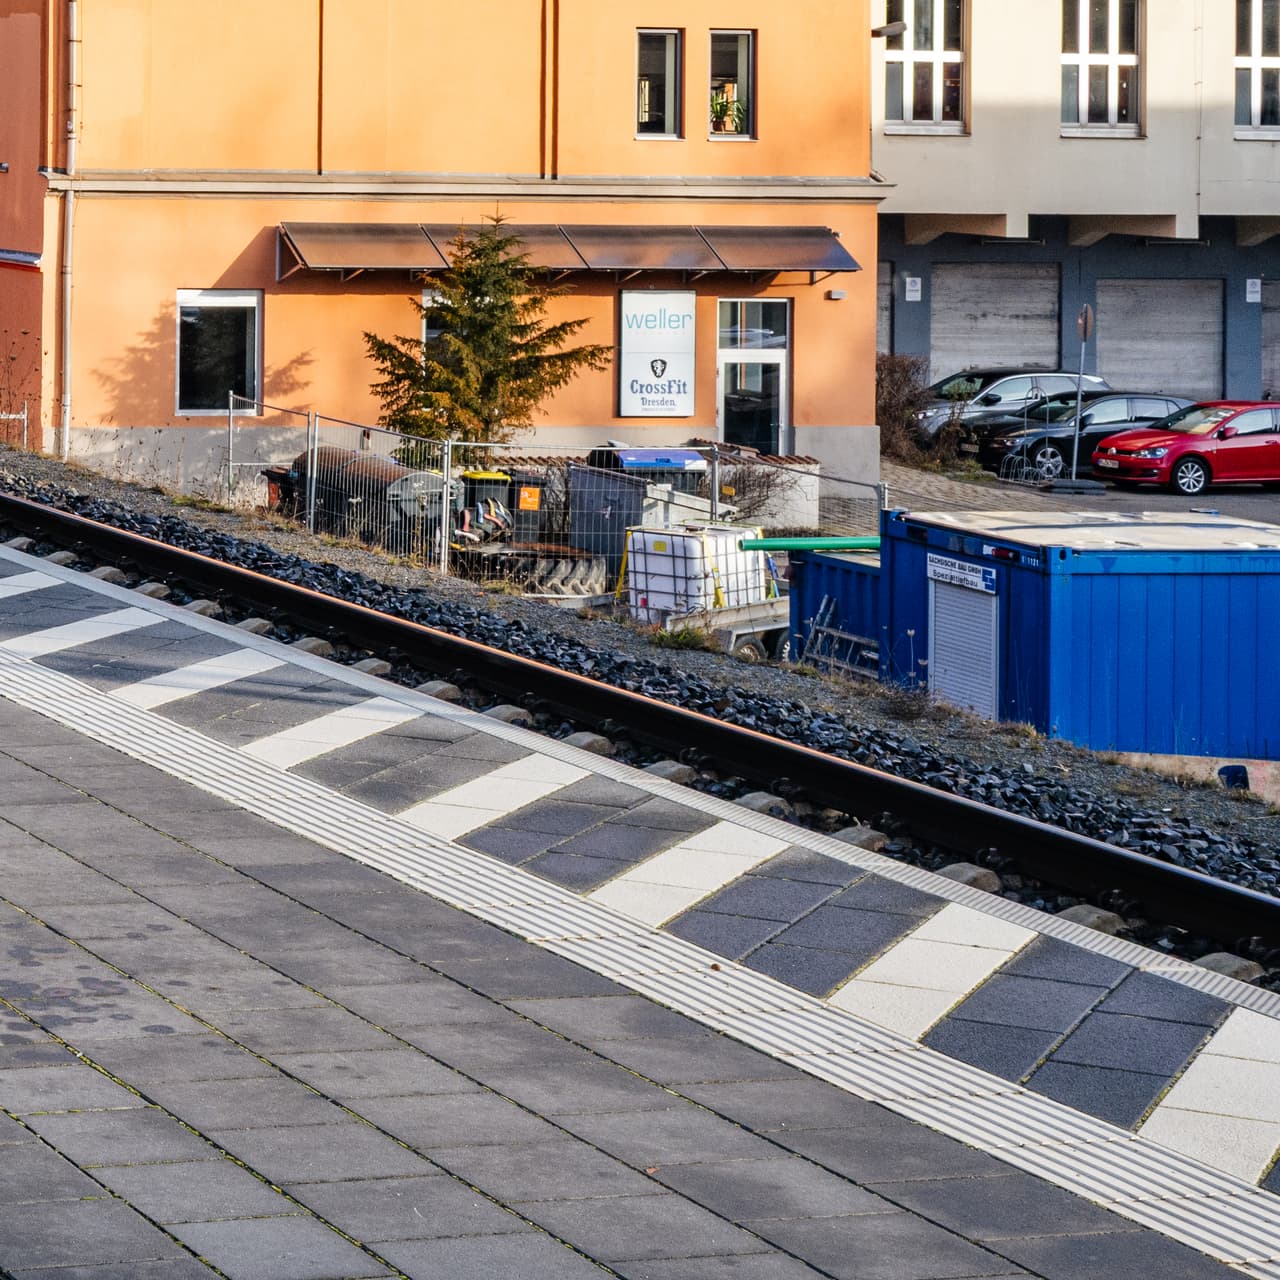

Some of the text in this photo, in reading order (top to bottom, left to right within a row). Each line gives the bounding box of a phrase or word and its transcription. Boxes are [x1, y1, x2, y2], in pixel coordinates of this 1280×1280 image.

[625, 307, 692, 329] weller
[630, 379, 687, 394] CrossFit
[957, 562, 967, 572] BAU
